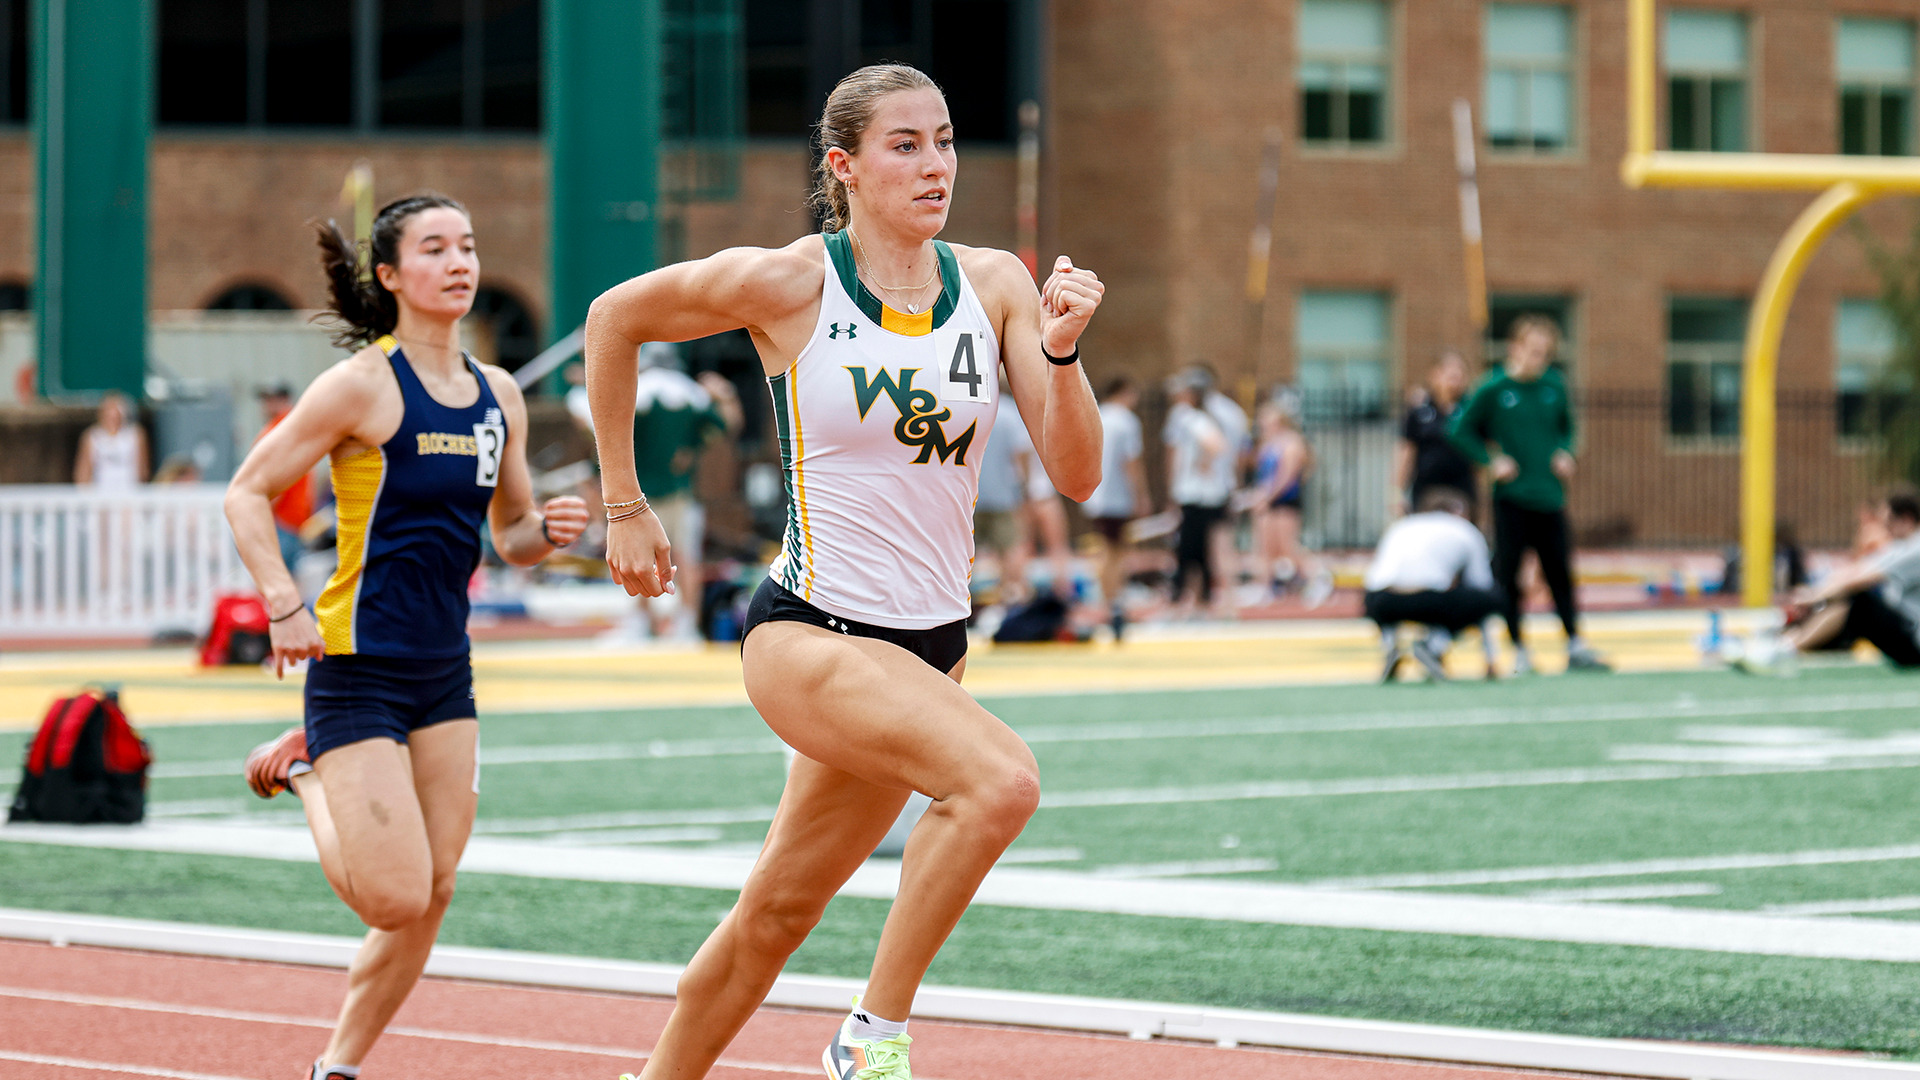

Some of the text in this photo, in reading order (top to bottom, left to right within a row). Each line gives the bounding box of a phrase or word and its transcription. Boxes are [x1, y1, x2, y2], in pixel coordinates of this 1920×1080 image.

[949, 333, 982, 397] 4
[416, 432, 477, 456] ROCHES
[841, 365, 977, 466] W&M
[484, 428, 498, 481] 3
